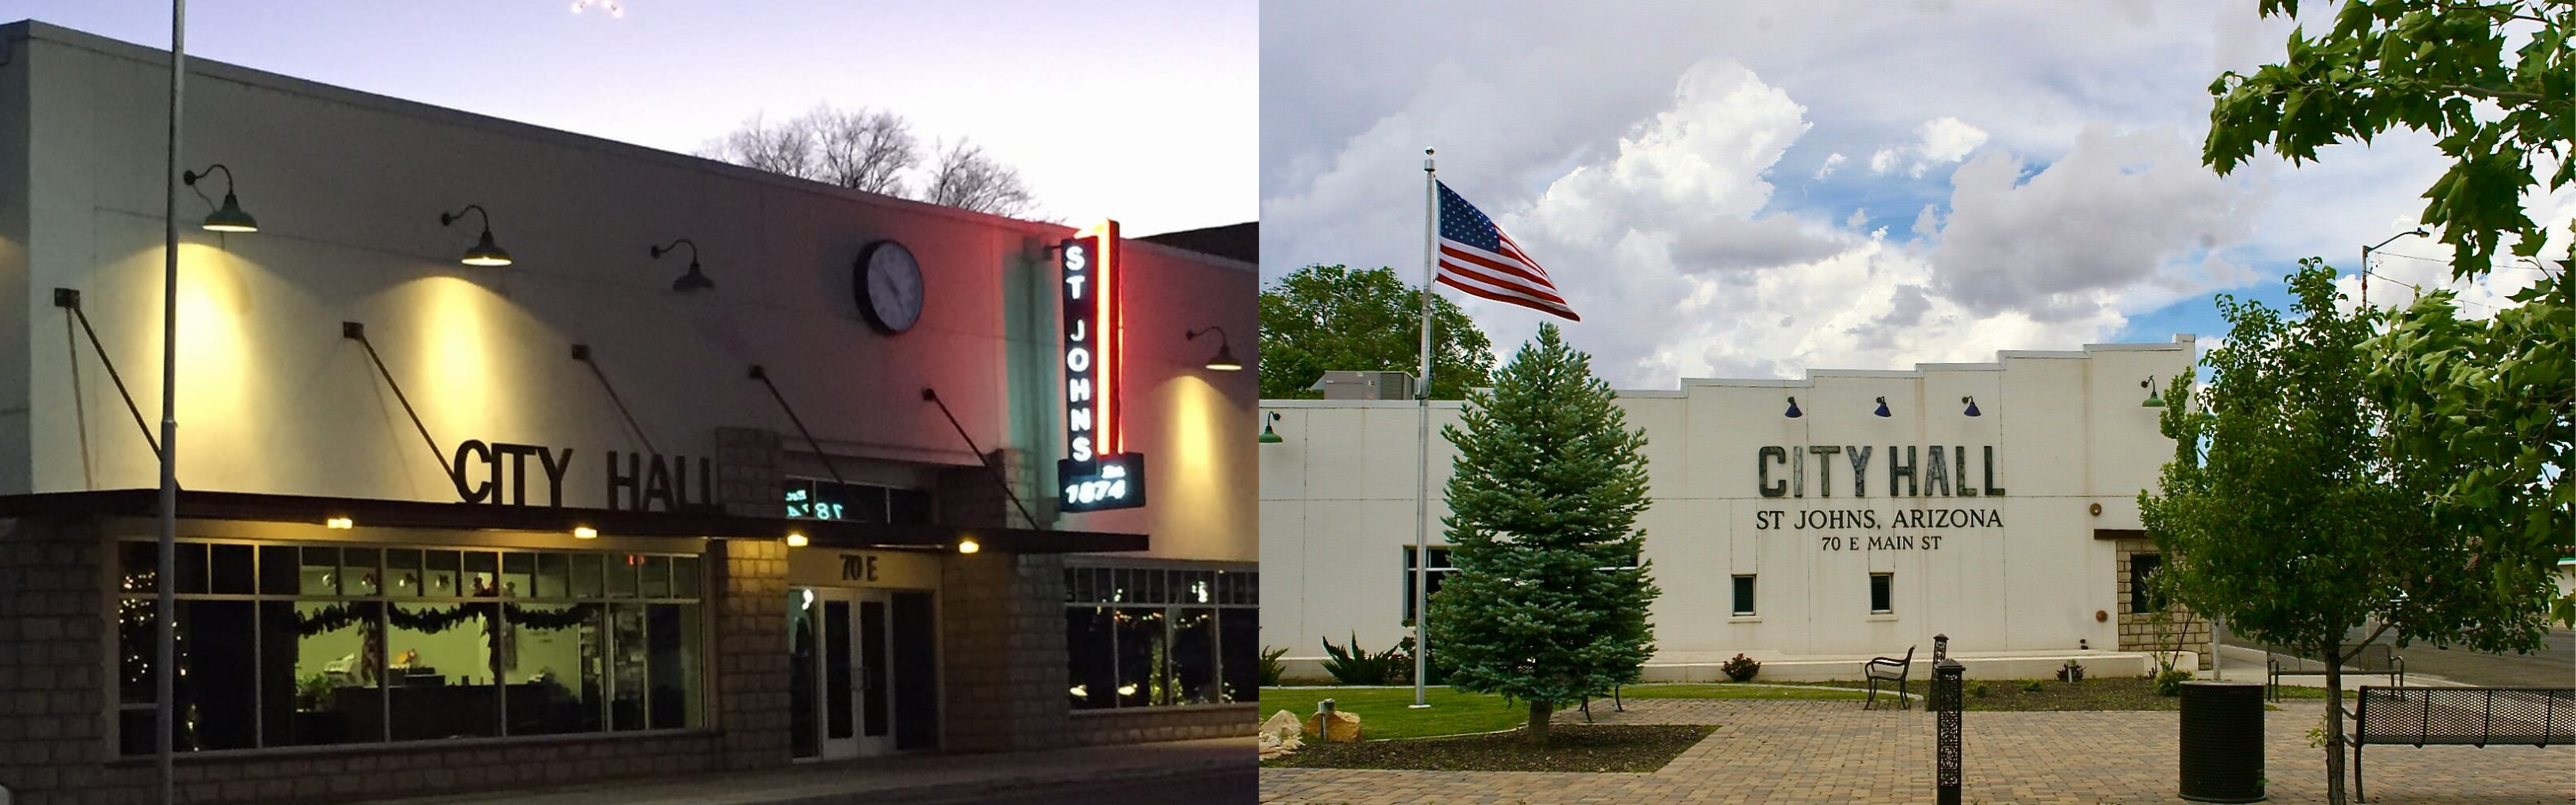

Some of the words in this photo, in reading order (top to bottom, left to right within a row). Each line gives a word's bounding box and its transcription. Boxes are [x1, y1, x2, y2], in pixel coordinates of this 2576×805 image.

[1065, 246, 1086, 300] ST
[1067, 319, 1092, 462] JOHNS
[454, 439, 574, 509] CITY
[607, 450, 725, 515] HALL
[1758, 445, 1872, 497] CITY
[1889, 445, 2006, 497] HALL
[1066, 480, 1126, 504] 1874
[1756, 510, 1785, 530] ST
[1794, 510, 1881, 530] JOHNS,
[1892, 509, 2004, 528] ARIZONA
[1822, 537, 1841, 551] 70
[1849, 537, 1860, 551] E
[1868, 536, 1913, 550] MAIN
[1922, 536, 1942, 550] ST
[840, 554, 862, 580] 70
[866, 555, 878, 581] E
